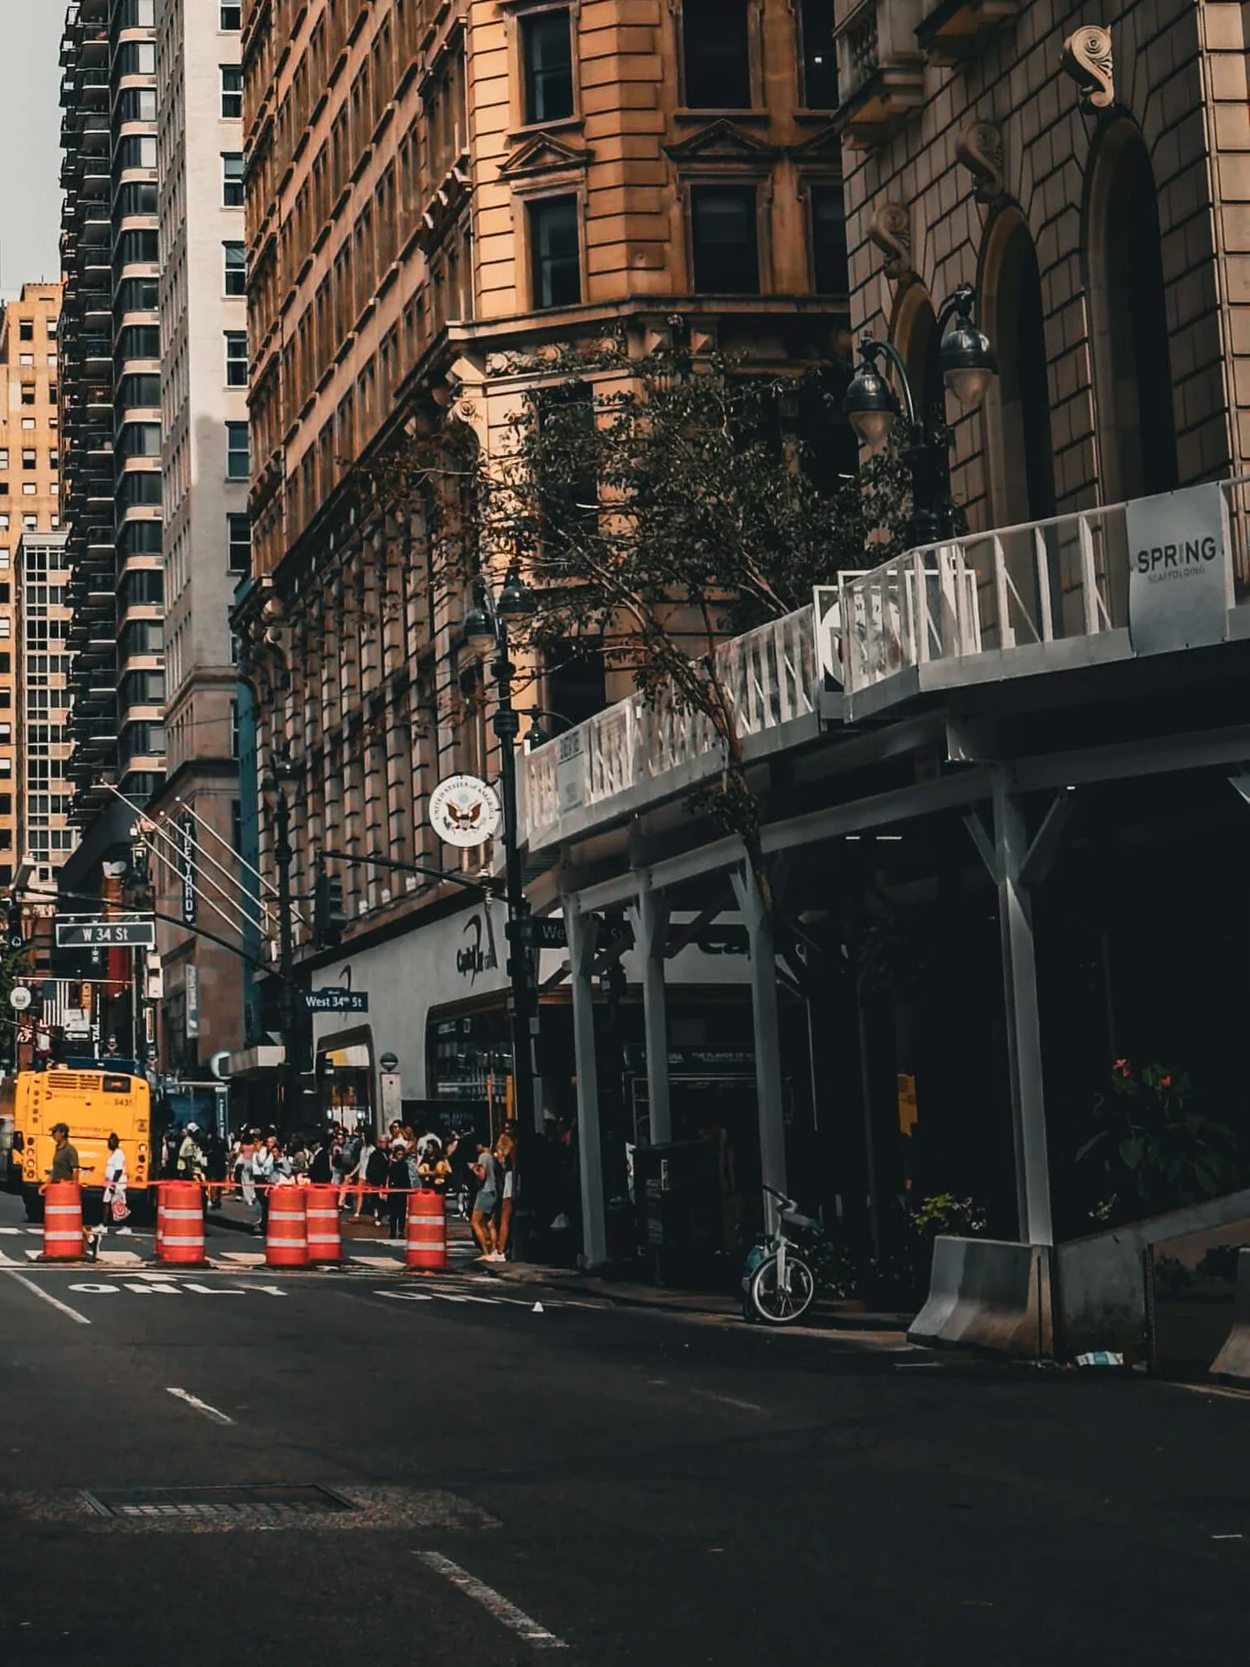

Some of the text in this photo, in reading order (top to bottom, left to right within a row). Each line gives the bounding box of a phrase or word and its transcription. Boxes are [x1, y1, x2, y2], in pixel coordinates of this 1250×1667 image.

[1138, 537, 1216, 573] SPRING
[82, 927, 129, 941] W 34 St
[305, 996, 363, 1007] West 34th St
[67, 1283, 290, 1296] ONLY
